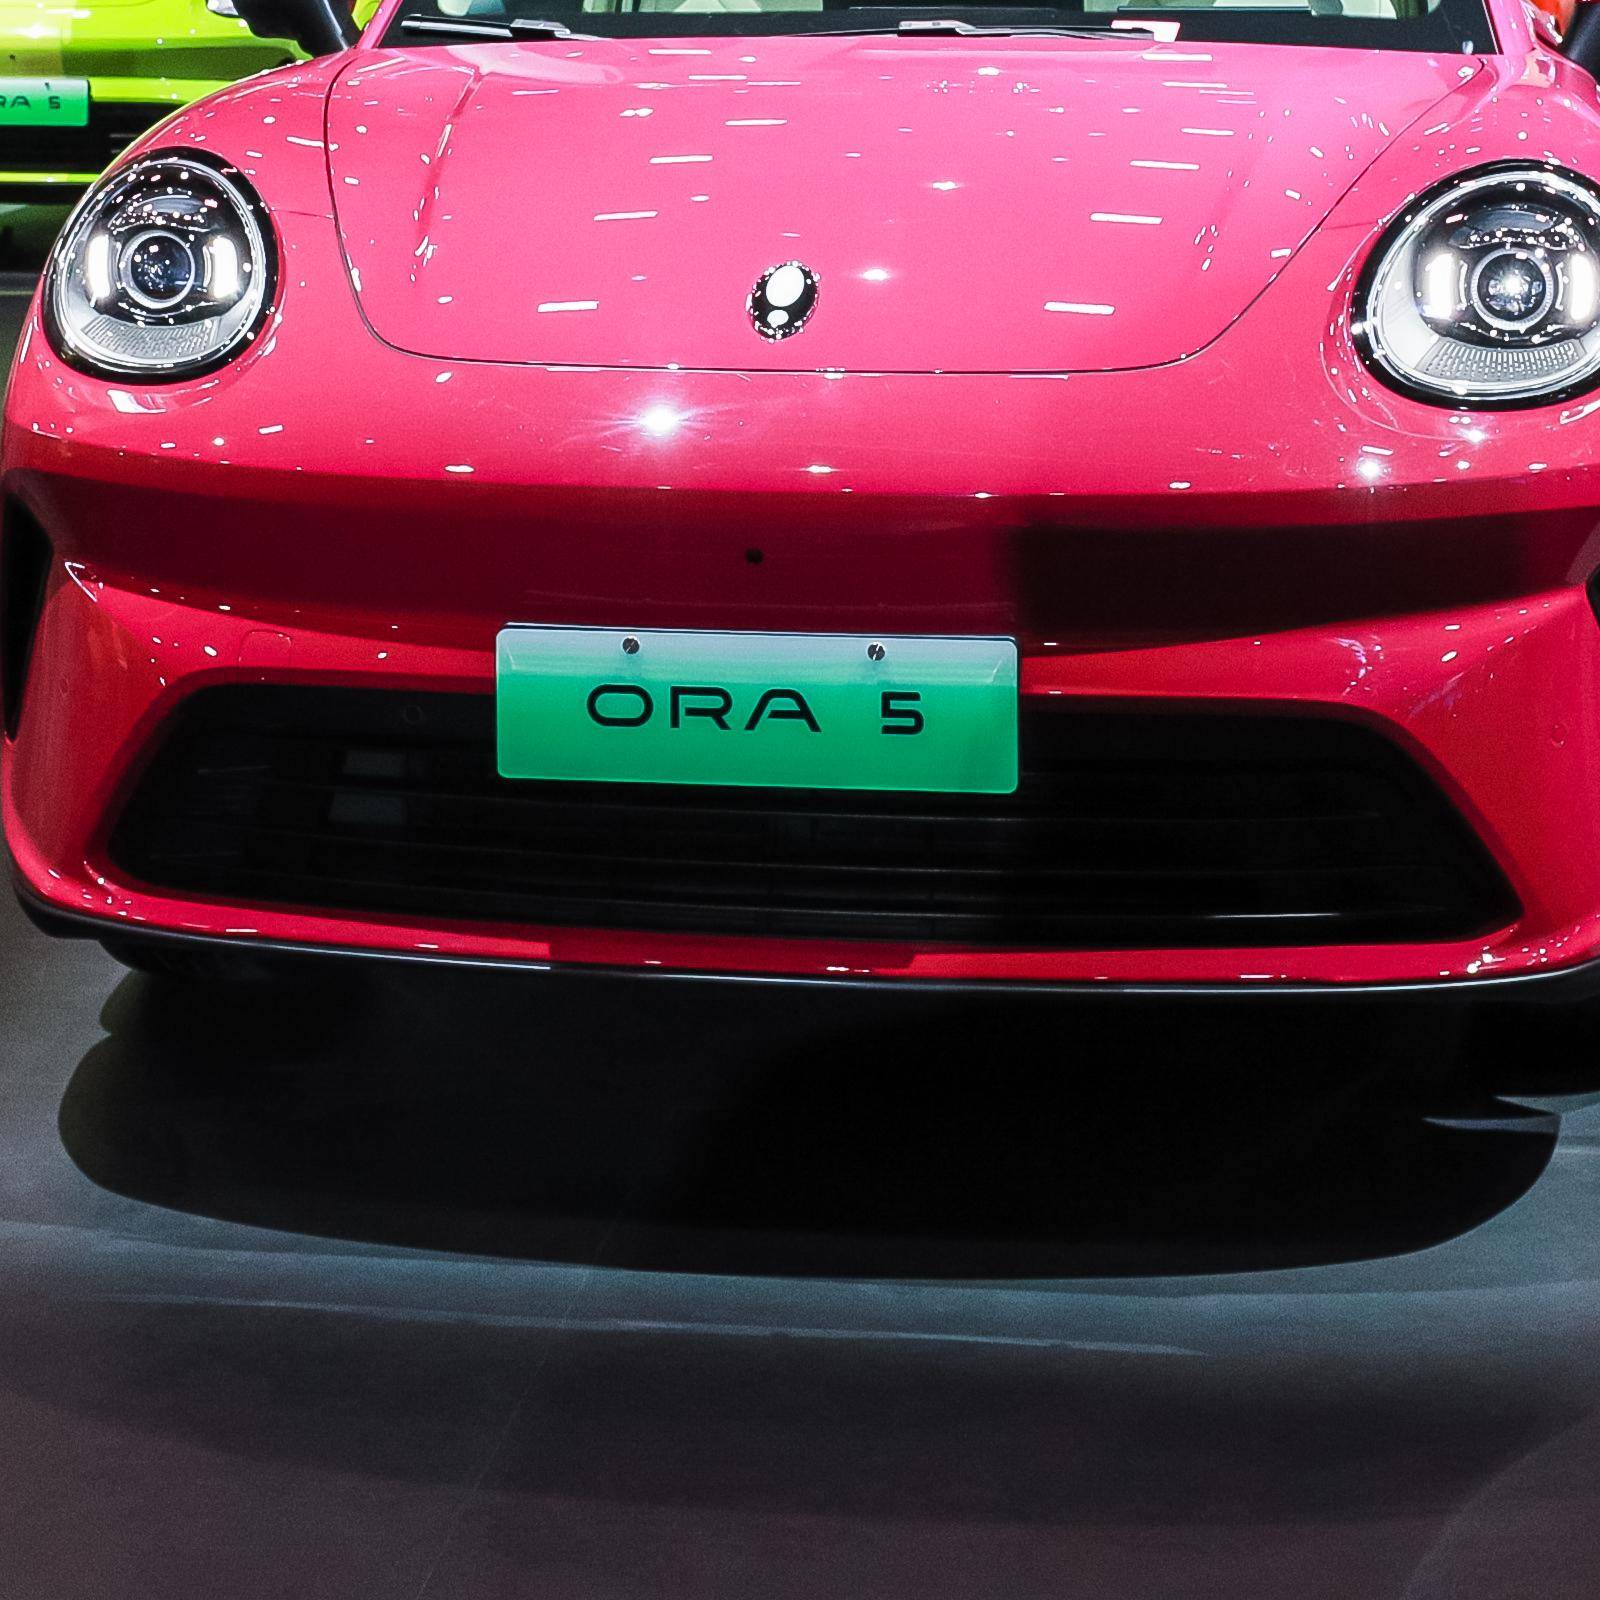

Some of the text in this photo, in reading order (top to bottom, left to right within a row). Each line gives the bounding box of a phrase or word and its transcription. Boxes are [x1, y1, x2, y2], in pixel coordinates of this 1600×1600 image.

[48, 96, 61, 110] 5
[586, 684, 925, 736] ORA 5
